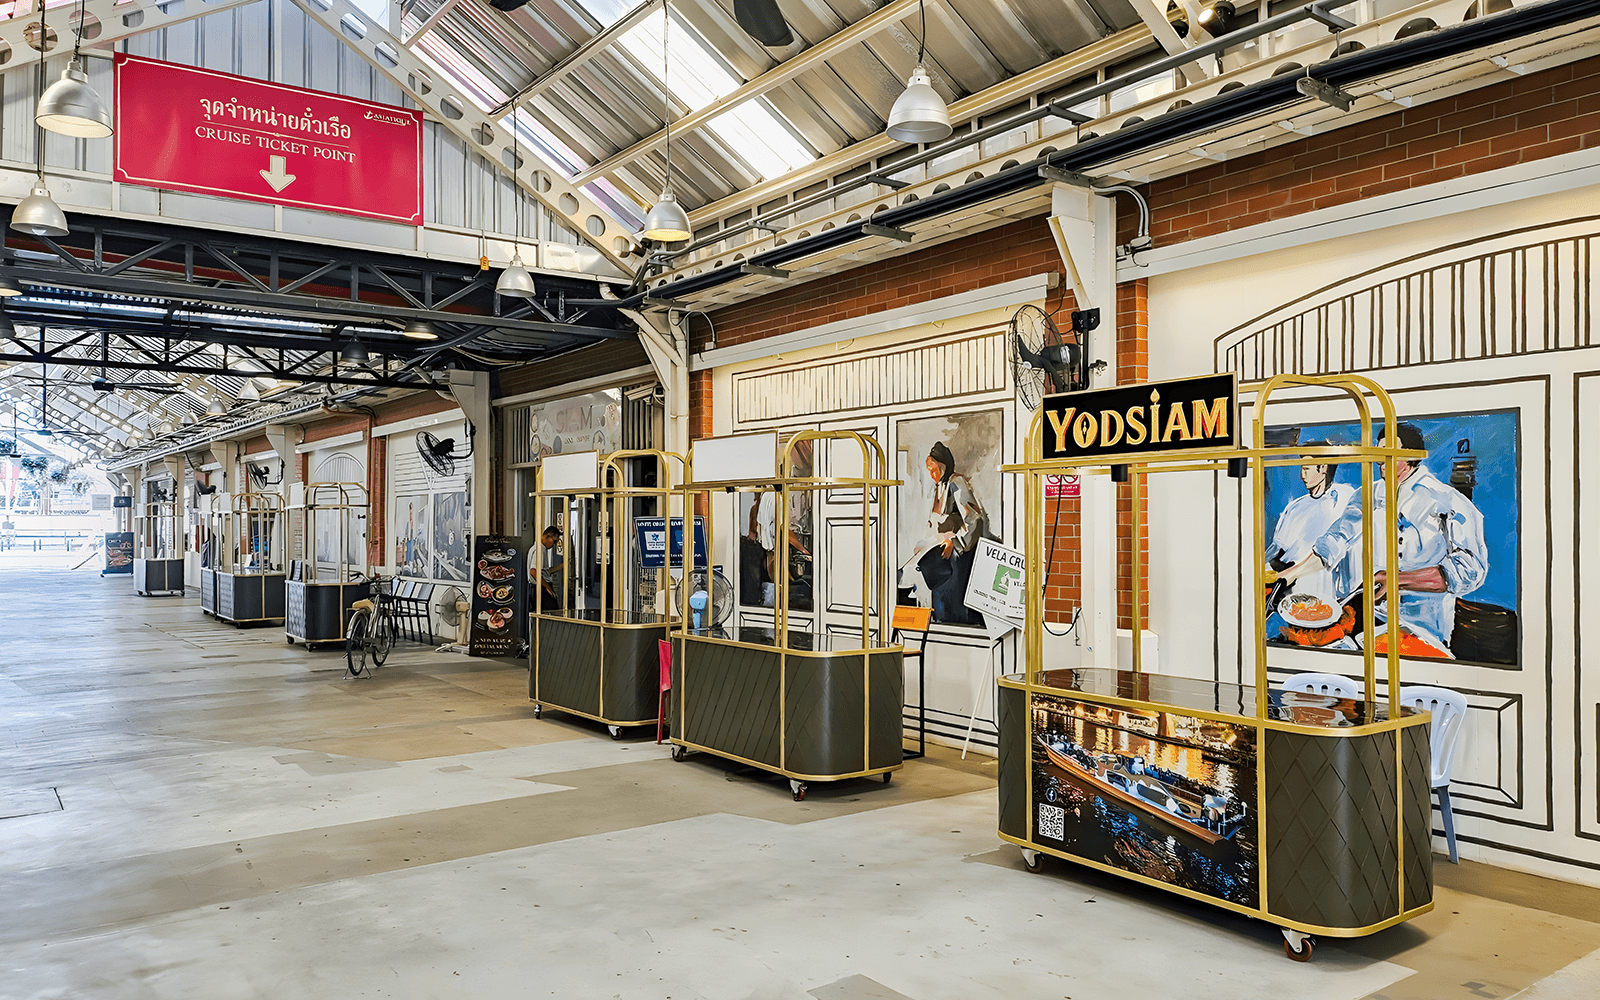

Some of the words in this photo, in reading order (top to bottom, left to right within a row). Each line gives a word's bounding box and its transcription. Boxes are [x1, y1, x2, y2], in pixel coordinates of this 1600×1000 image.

[199, 97, 351, 139] จุดจำหน่ายตั๋วเรือ
[195, 126, 251, 145] CRUISE
[256, 136, 309, 155] TICKET
[313, 147, 356, 163] POINT
[986, 546, 1007, 563] VELA
[1009, 555, 1026, 570] CRU
